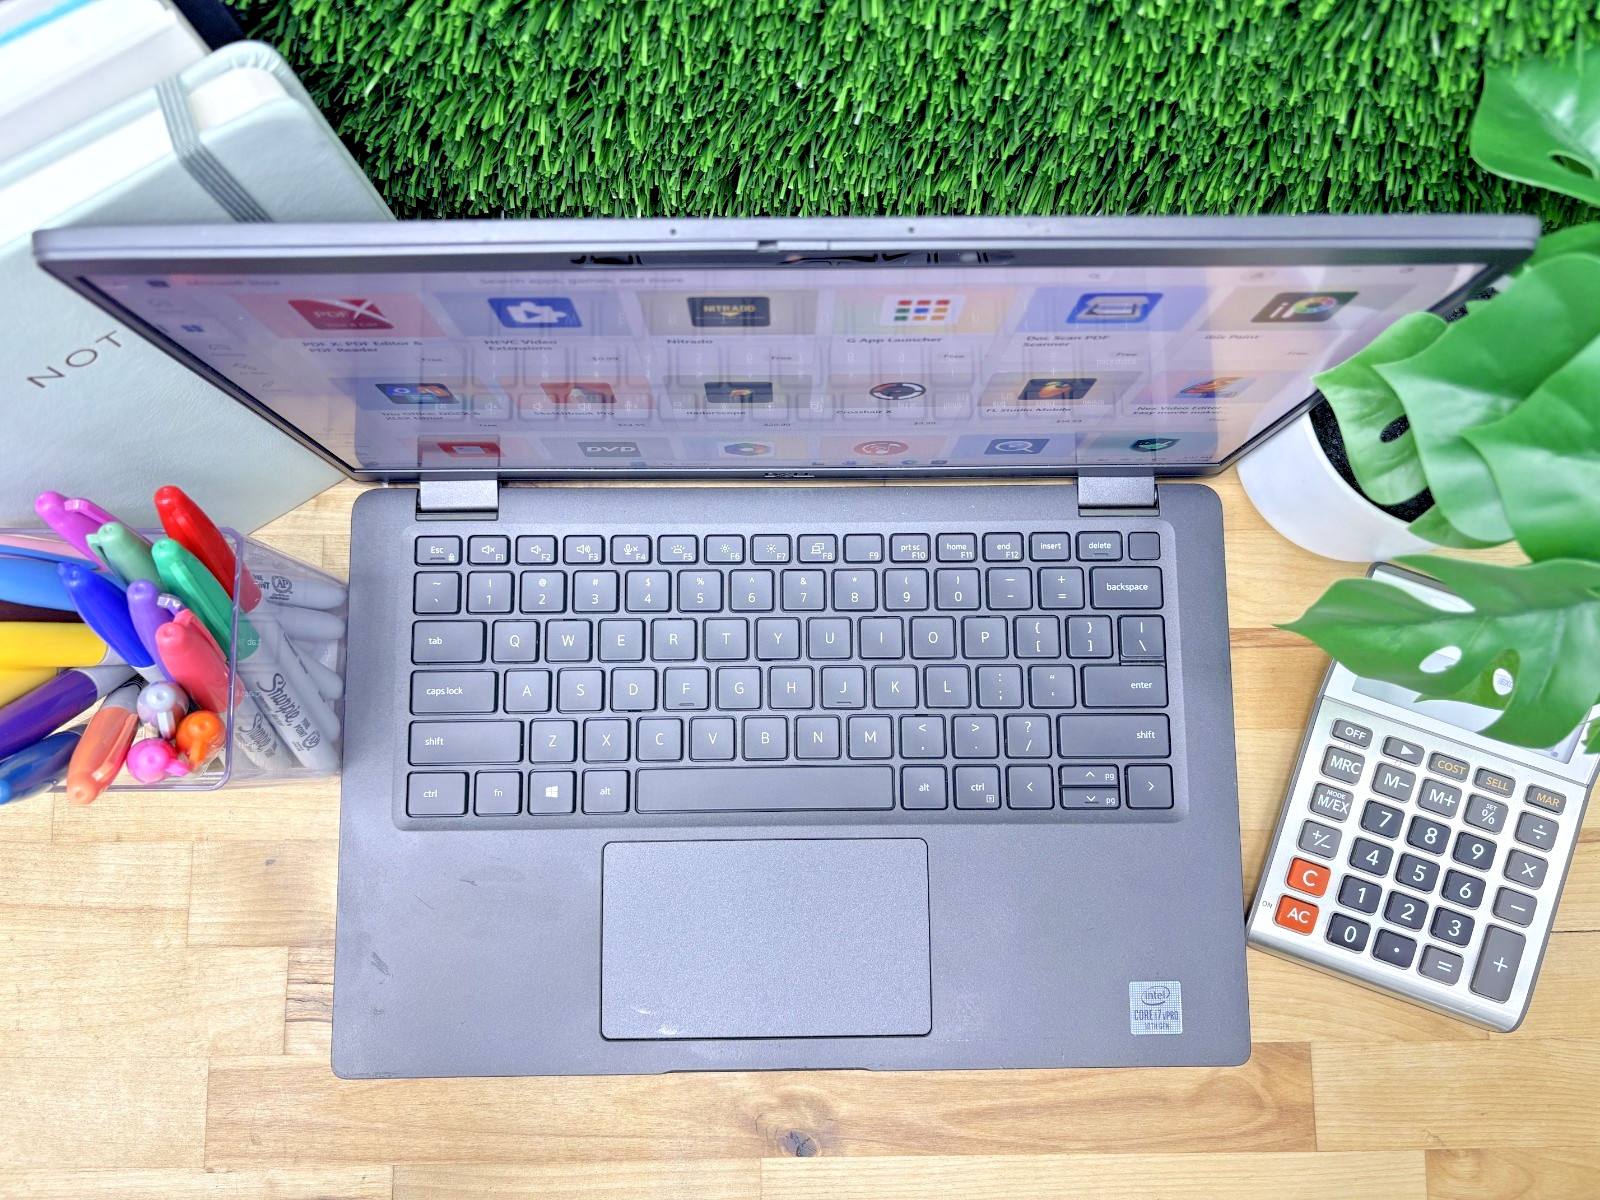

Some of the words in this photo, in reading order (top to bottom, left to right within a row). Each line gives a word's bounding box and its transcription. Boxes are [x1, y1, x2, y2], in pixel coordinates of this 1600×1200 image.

[480, 277, 525, 285] Search
[703, 304, 756, 313] NITRADO
[901, 544, 911, 552] prt
[1040, 542, 1061, 550] insert
[1088, 541, 1112, 549] delete
[1106, 583, 1148, 592] backspace
[486, 595, 491, 604] 1
[539, 594, 545, 604] 2
[592, 594, 599, 604] 3
[644, 594, 652, 603] 4
[696, 593, 704, 603] 5
[748, 593, 756, 603] 6
[800, 593, 807, 602] 7
[851, 592, 859, 602] 8
[903, 592, 910, 602] 9
[954, 592, 962, 602] 0
[510, 635, 520, 648] Q
[562, 635, 575, 646] W
[618, 635, 625, 646] E
[669, 634, 678, 645] R
[722, 633, 731, 644] T
[774, 633, 783, 644] Y
[825, 632, 835, 644] U
[928, 632, 938, 644] O
[981, 632, 990, 643] P
[426, 687, 445, 697] caps
[446, 687, 463, 695] lock
[522, 685, 532, 697] A
[577, 684, 585, 696] S
[629, 684, 638, 695] D
[683, 683, 690, 694] F
[734, 682, 744, 694] G
[787, 682, 796, 693] H
[840, 682, 846, 694] J
[891, 681, 900, 692] K
[944, 681, 951, 692] L
[256, 672, 300, 724] Sharpie
[655, 733, 664, 745] C
[708, 733, 717, 744] V
[762, 732, 769, 744] B
[813, 732, 823, 743] N
[864, 731, 876, 742] M
[1136, 731, 1155, 739] shift
[1345, 727, 1366, 740] OFF
[425, 737, 444, 746] shift
[549, 735, 556, 747] Z
[602, 734, 611, 746] X
[1330, 755, 1362, 775] MRC
[1437, 759, 1467, 775] COST
[918, 783, 930, 791] alt
[970, 783, 985, 791] ctrl
[1486, 776, 1508, 791] SELL
[423, 789, 438, 798] ctrl
[494, 789, 503, 797] fn
[600, 787, 611, 795] alt
[1326, 789, 1347, 800] MODE
[1429, 788, 1456, 807] M+
[1536, 792, 1560, 807] MAR
[1317, 795, 1349, 814] M/EX
[1485, 803, 1498, 812] SET
[1379, 811, 1392, 828] 7
[1424, 827, 1438, 844] 8
[1366, 849, 1380, 866] 4
[1471, 844, 1484, 860] 9
[1302, 870, 1318, 887] C
[1412, 864, 1427, 882] 5
[1358, 887, 1366, 904] 1
[1459, 883, 1472, 899] 6
[1262, 900, 1273, 909] ON
[1287, 907, 1310, 924] AC
[1400, 903, 1415, 921] 2
[1448, 919, 1462, 936] 3
[1344, 925, 1357, 943] 0
[1144, 990, 1166, 1000] intel
[1135, 1010, 1153, 1020] CORE
